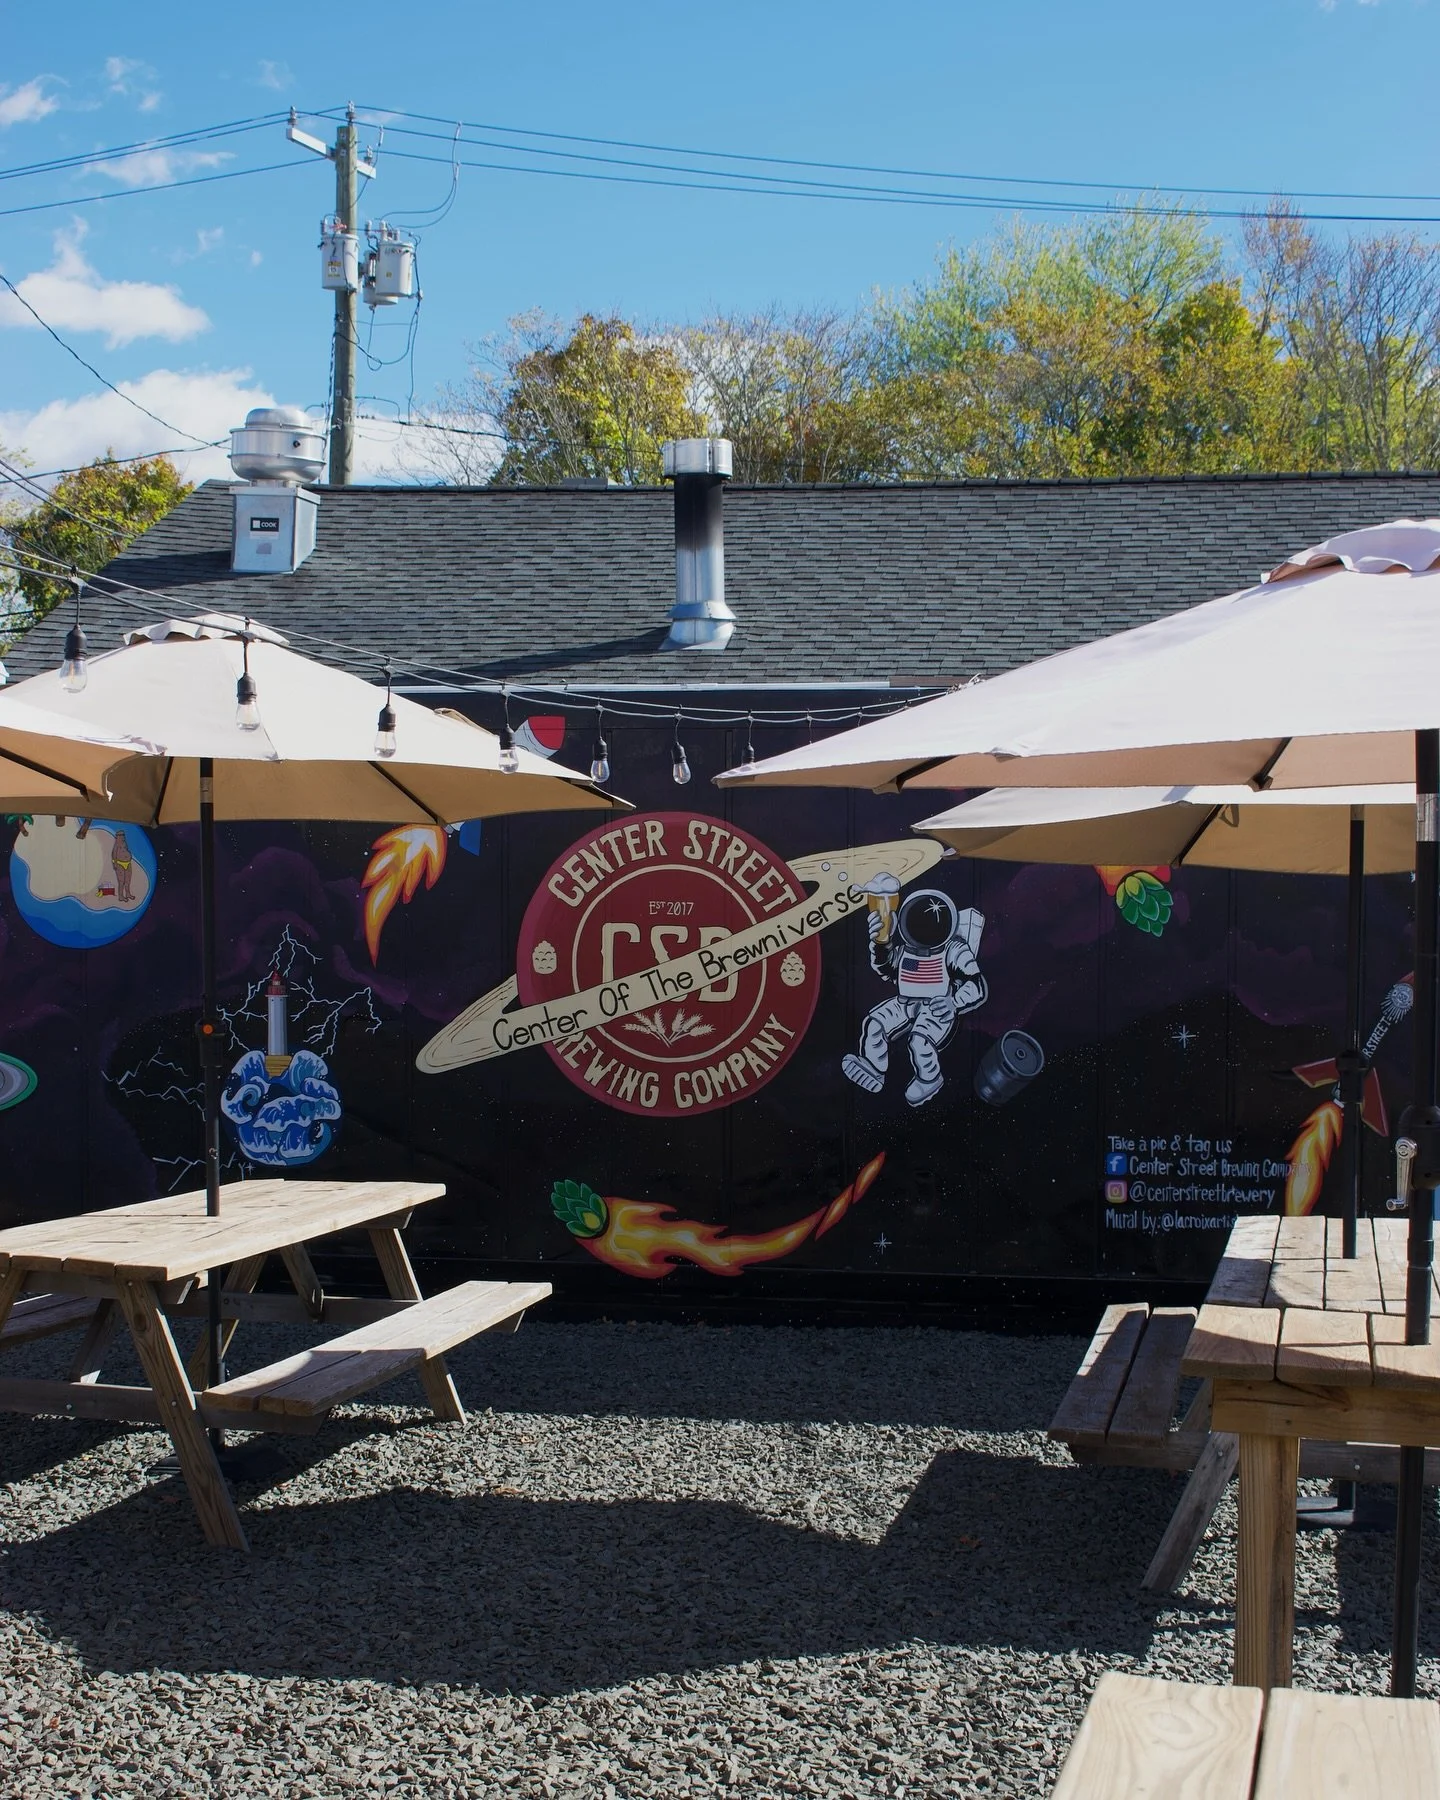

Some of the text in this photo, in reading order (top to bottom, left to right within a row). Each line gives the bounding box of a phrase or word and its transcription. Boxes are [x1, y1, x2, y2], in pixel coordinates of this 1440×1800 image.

[547, 819, 798, 913] CENTER STREET
[667, 901, 695, 917] 2017
[492, 884, 865, 1051] Center Of The Brewniverse
[1366, 1016, 1391, 1050] STREET
[552, 1012, 797, 1110] REWING COMPANY
[1107, 1134, 1232, 1160] Take a pic & tag us
[1129, 1156, 1174, 1176] Center
[1177, 1157, 1217, 1177] Street
[1221, 1159, 1260, 1183] Brewing
[1129, 1180, 1276, 1209] @centerstreetbrewery
[1106, 1208, 1137, 1229] Mural
